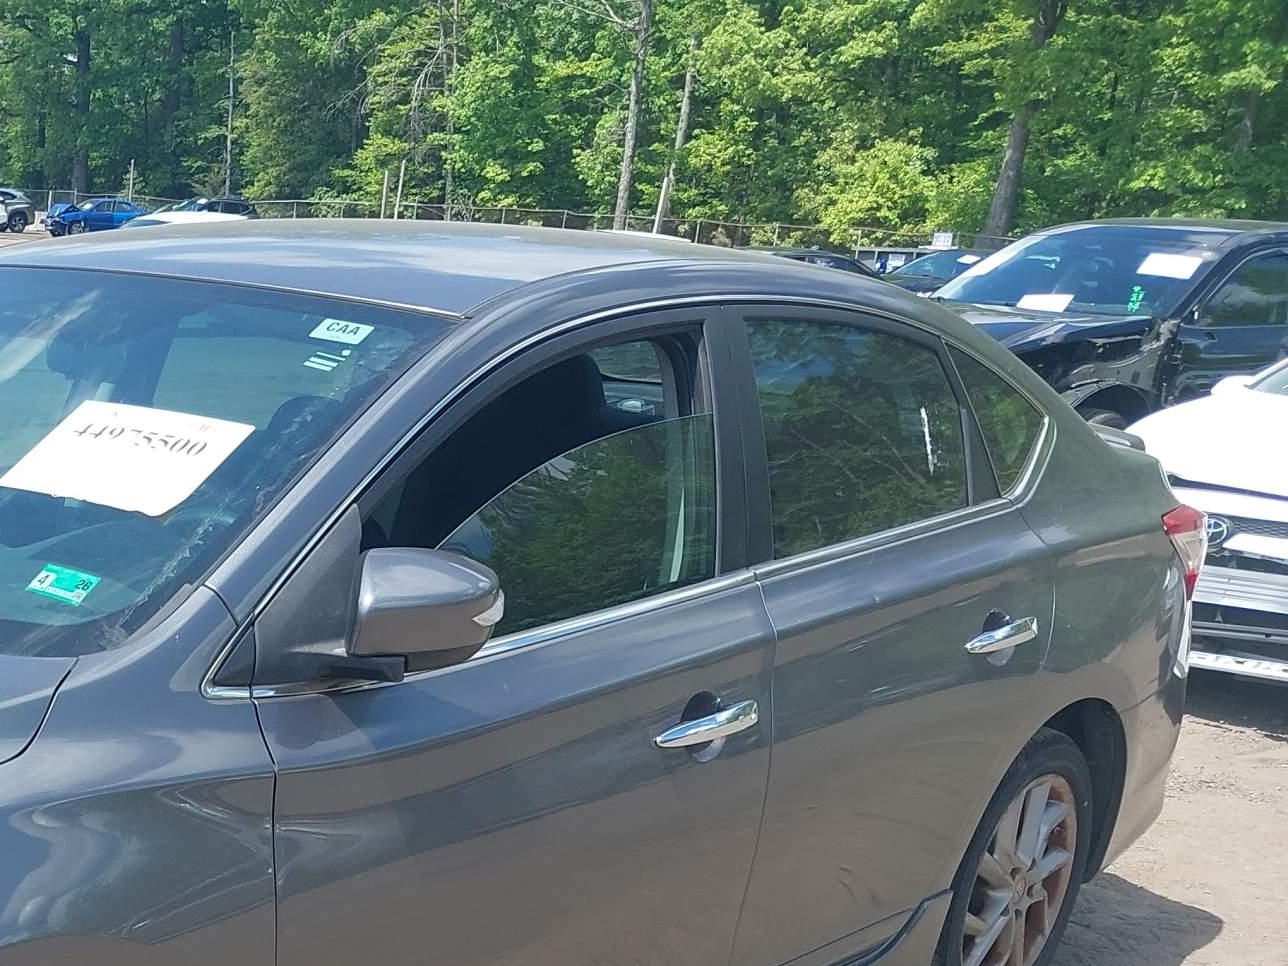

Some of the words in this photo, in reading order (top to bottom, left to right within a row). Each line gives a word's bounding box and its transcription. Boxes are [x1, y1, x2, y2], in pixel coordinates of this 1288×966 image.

[326, 322, 361, 336] CAA
[37, 574, 51, 586] 4
[74, 579, 93, 592] 26
